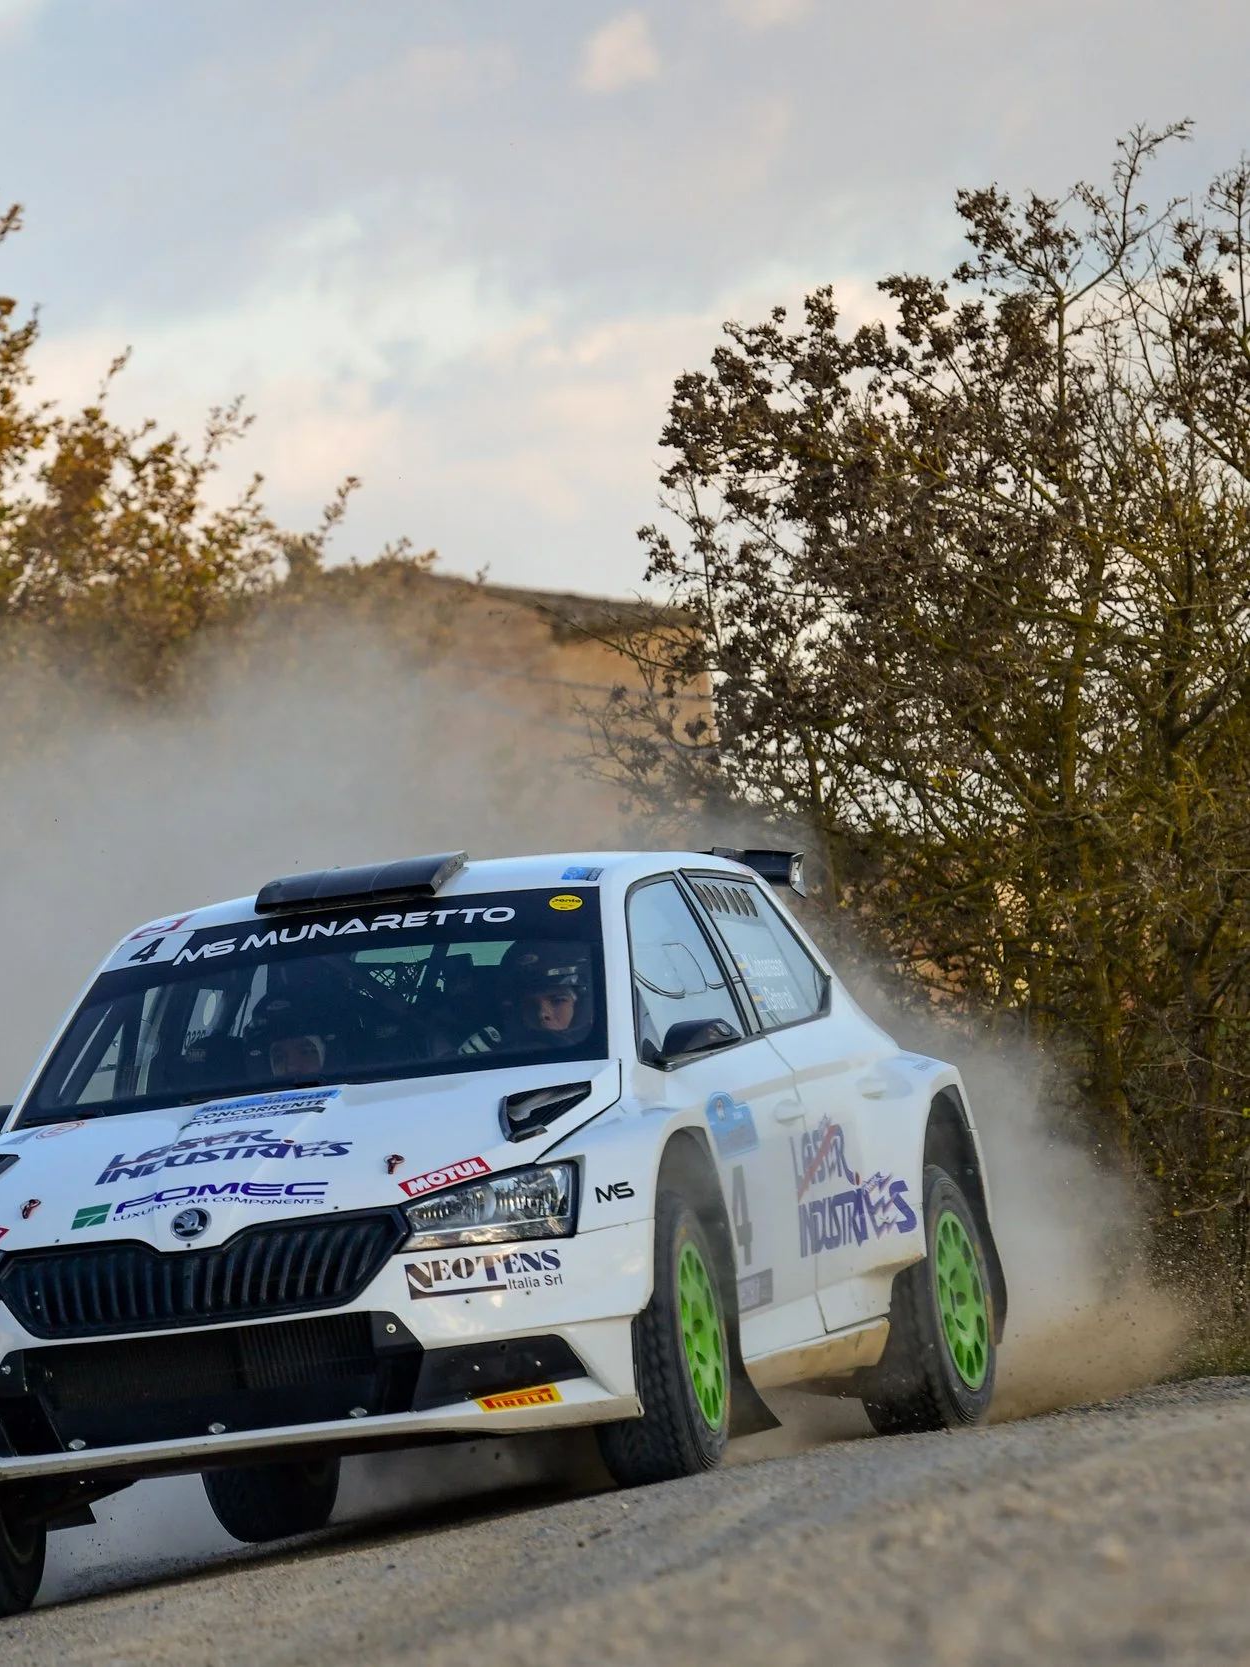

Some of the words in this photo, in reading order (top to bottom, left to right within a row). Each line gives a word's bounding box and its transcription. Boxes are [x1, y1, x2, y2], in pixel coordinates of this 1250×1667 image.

[128, 936, 166, 963] 4
[172, 937, 238, 966] MS
[239, 906, 515, 951] MUNARETTO
[192, 1099, 328, 1120] CONCORRENTE
[94, 1140, 353, 1186] INDUSTRIES
[105, 1129, 281, 1171] LASER
[407, 1158, 487, 1195] MOTUL
[595, 1181, 635, 1203] MS
[113, 1203, 170, 1222] LUXURY
[175, 1197, 209, 1207] CAR
[212, 1196, 325, 1205] COMPONENTS
[115, 1181, 328, 1214] FOMEC
[732, 1164, 753, 1266] 4
[798, 1177, 918, 1259] INDUSTRIES
[405, 1249, 561, 1289] NEOTENS
[507, 1275, 541, 1290] Italia
[544, 1273, 563, 1287] Srl
[481, 1387, 555, 1409] PIRELLI
